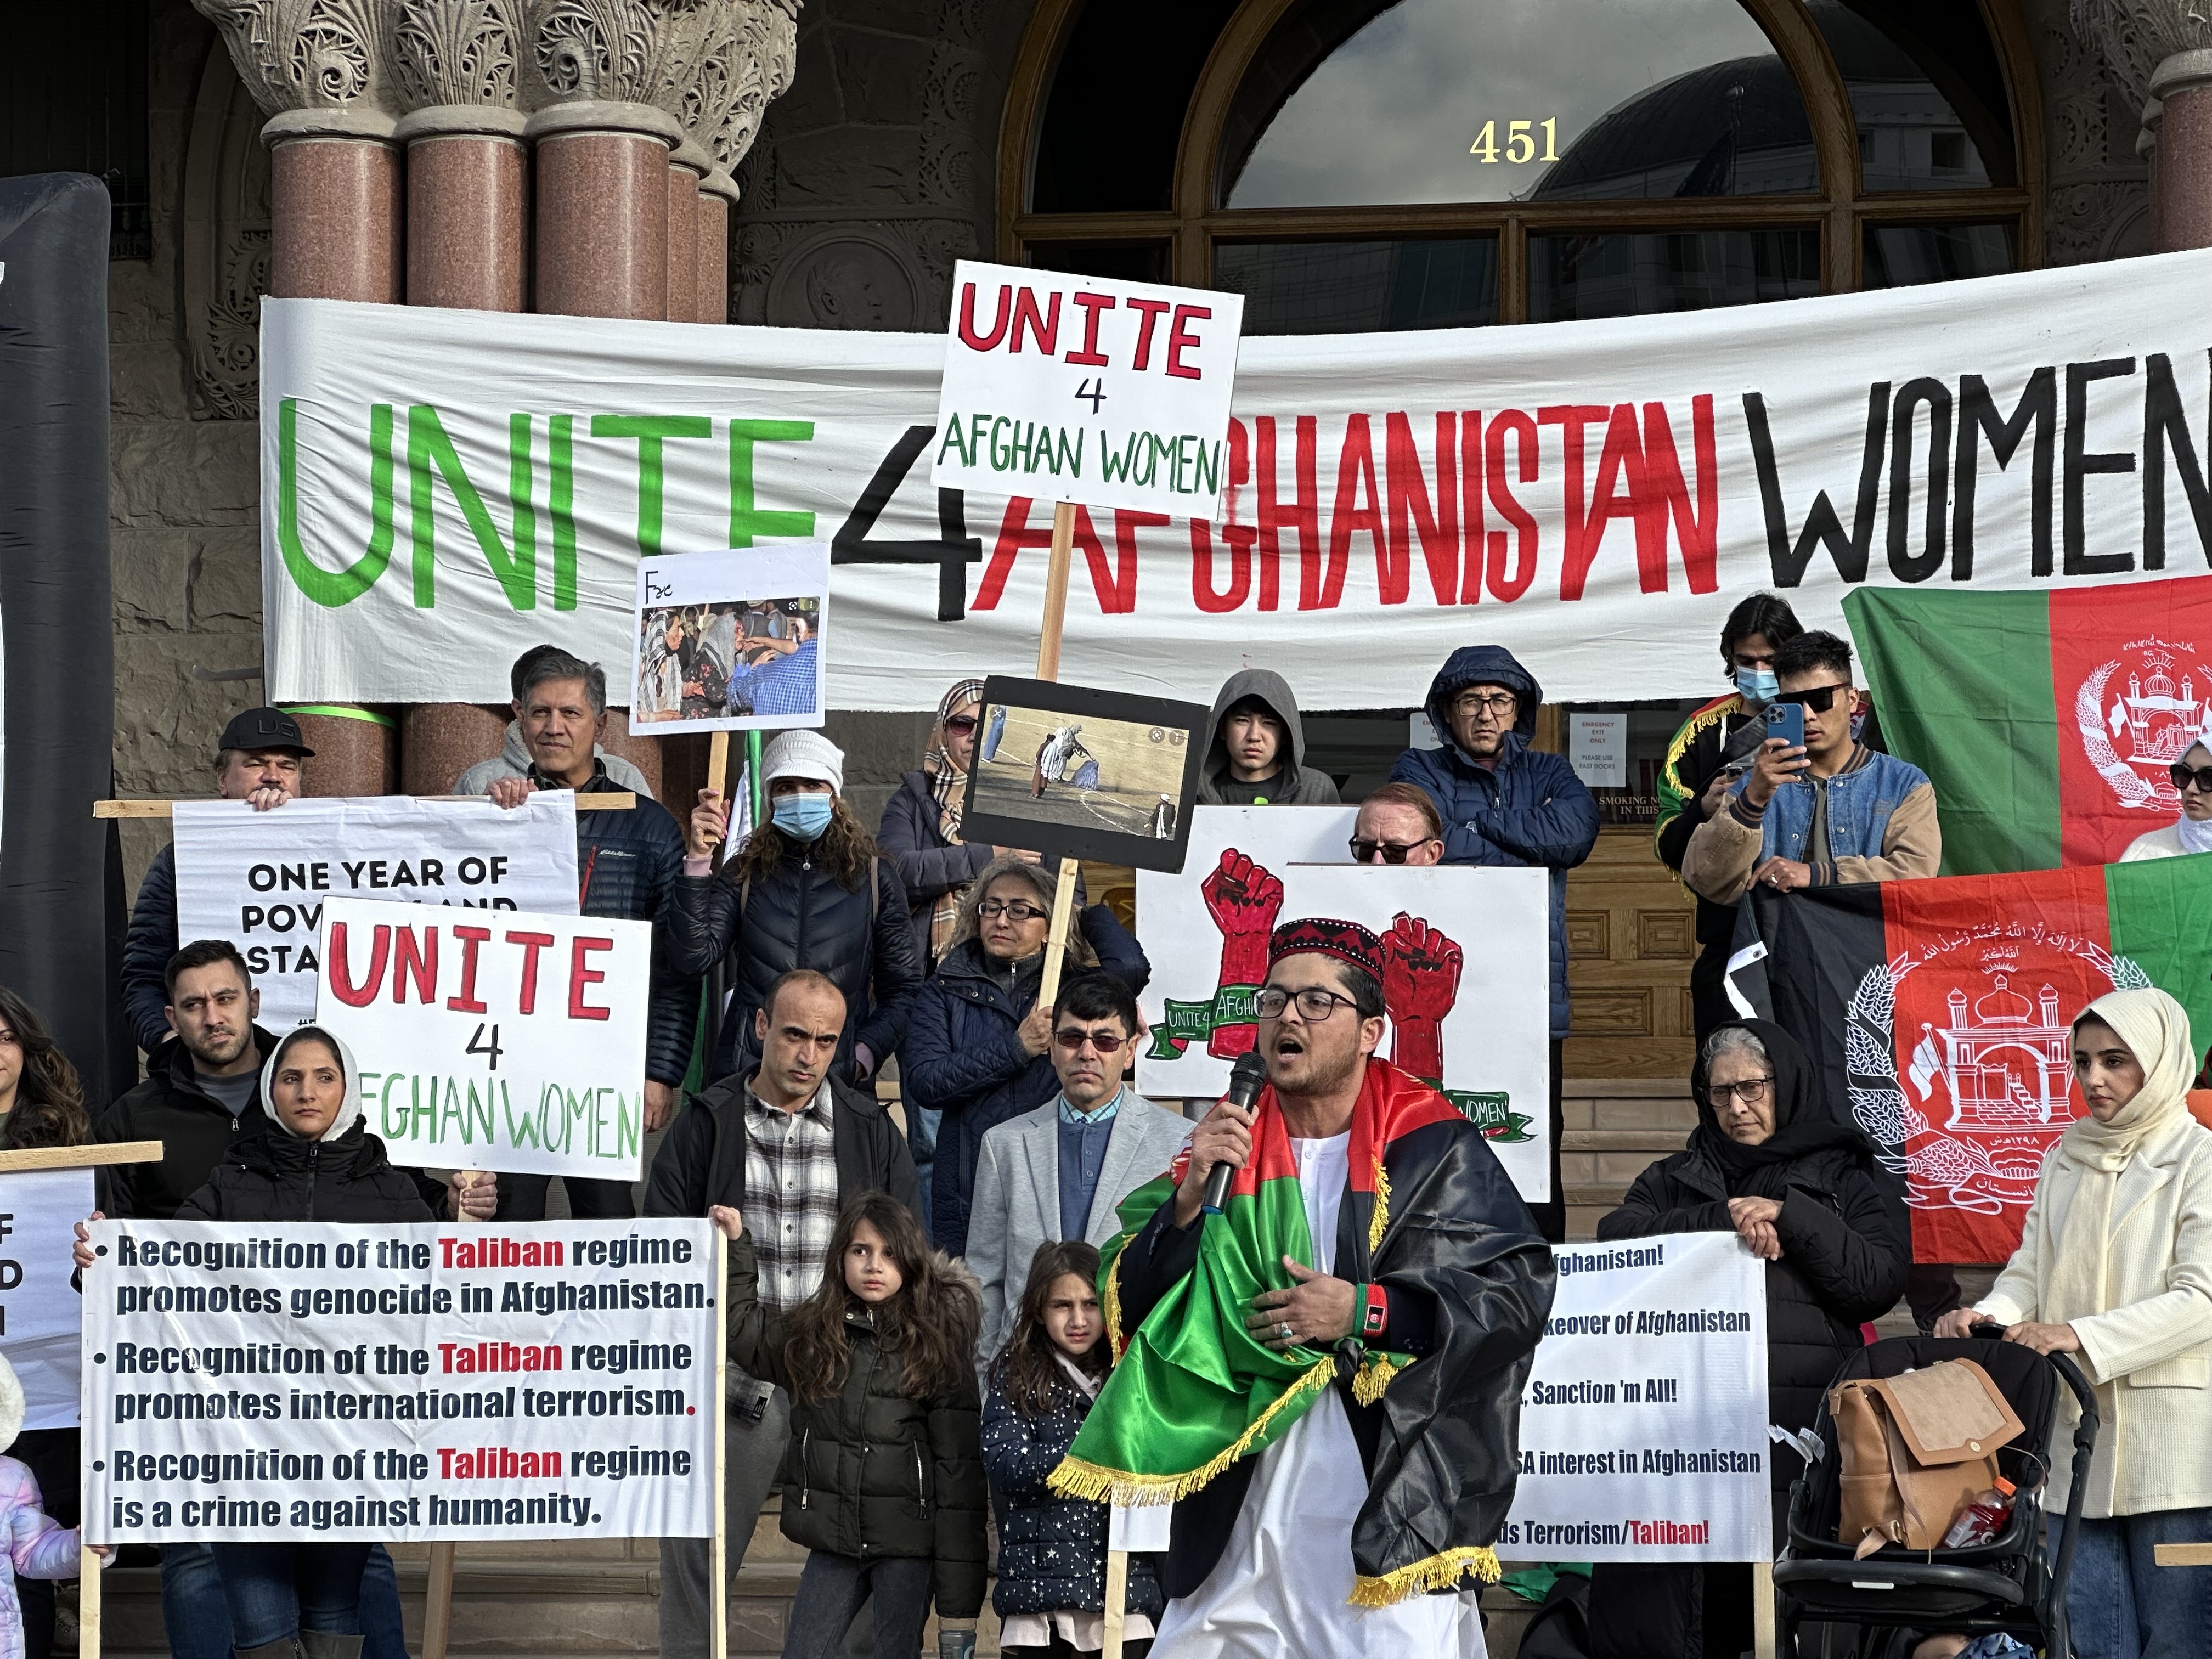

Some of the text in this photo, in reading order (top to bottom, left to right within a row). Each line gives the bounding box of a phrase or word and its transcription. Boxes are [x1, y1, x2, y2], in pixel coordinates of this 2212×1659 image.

[1469, 116, 1560, 163] 451
[958, 282, 1211, 380] UNITE
[1075, 377, 1107, 415] 4
[938, 412, 1220, 495] AFGHAN WOMEN
[832, 425, 982, 620] 4
[1599, 797, 1646, 805] SMOKING
[248, 856, 507, 891] ONE YEAR OF
[329, 922, 613, 1020] UNITE
[1215, 995, 1254, 1019] AFGH
[465, 1023, 503, 1070] 4
[358, 1073, 640, 1160] FGHAN WOMEN
[118, 1234, 692, 1271] Recognition of the Taliban regime
[1553, 1244, 1664, 1277] fghanistan!
[117, 1279, 714, 1318] promotes genocide in Afghanistan.
[1544, 1309, 1751, 1336] keover of Afghanistan
[116, 1339, 692, 1377] Recognition of the Taliban regime
[115, 1385, 696, 1423] promotes international terrorism.
[1533, 1379, 1678, 1406] Sanction 'm All!
[114, 1445, 691, 1483] Recognition of the Taliban regime
[1540, 1451, 1615, 1475] interest
[1620, 1450, 1638, 1474] in
[1643, 1449, 1760, 1477] Afghanistan
[113, 1492, 601, 1530] is a crime against humanity.
